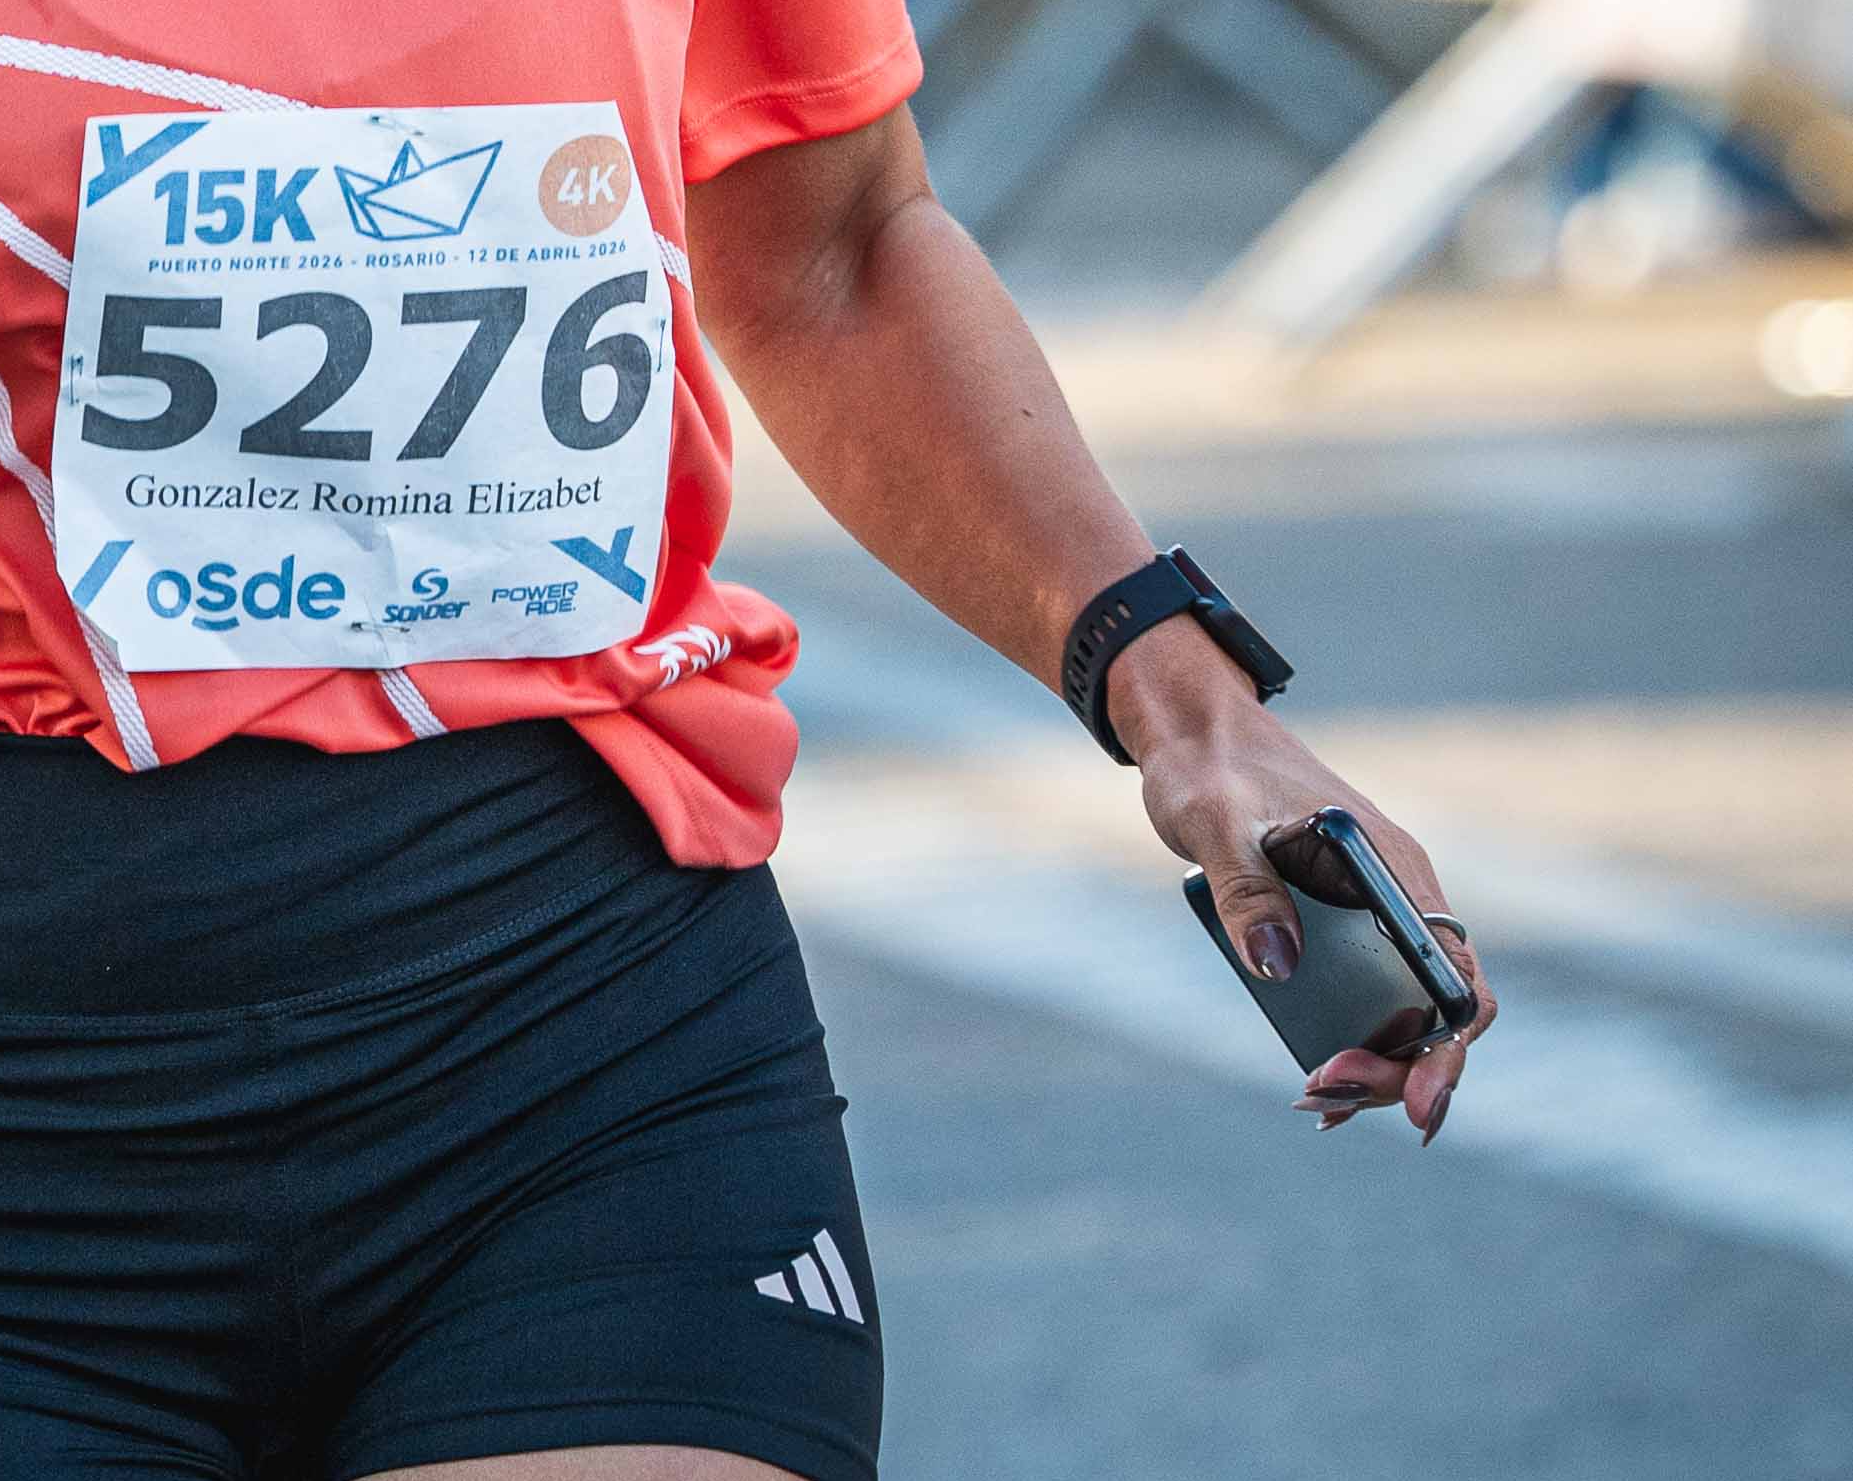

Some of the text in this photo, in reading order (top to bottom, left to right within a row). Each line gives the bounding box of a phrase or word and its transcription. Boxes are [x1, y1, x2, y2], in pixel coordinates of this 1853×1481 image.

[557, 163, 617, 205] 4K
[154, 168, 319, 245] 15K
[148, 257, 222, 273] PUERTO
[230, 255, 290, 271] NORTE
[298, 254, 343, 269] 2026
[366, 250, 446, 268] ROSARIO
[469, 249, 487, 263] 12
[497, 247, 520, 262] DE
[527, 243, 581, 261] ABRIL
[588, 240, 627, 258] 2026
[80, 270, 653, 461] 5276
[125, 473, 604, 517] Gonzalez Romina Elizabet
[146, 554, 346, 631] osde
[492, 581, 578, 603] POWER
